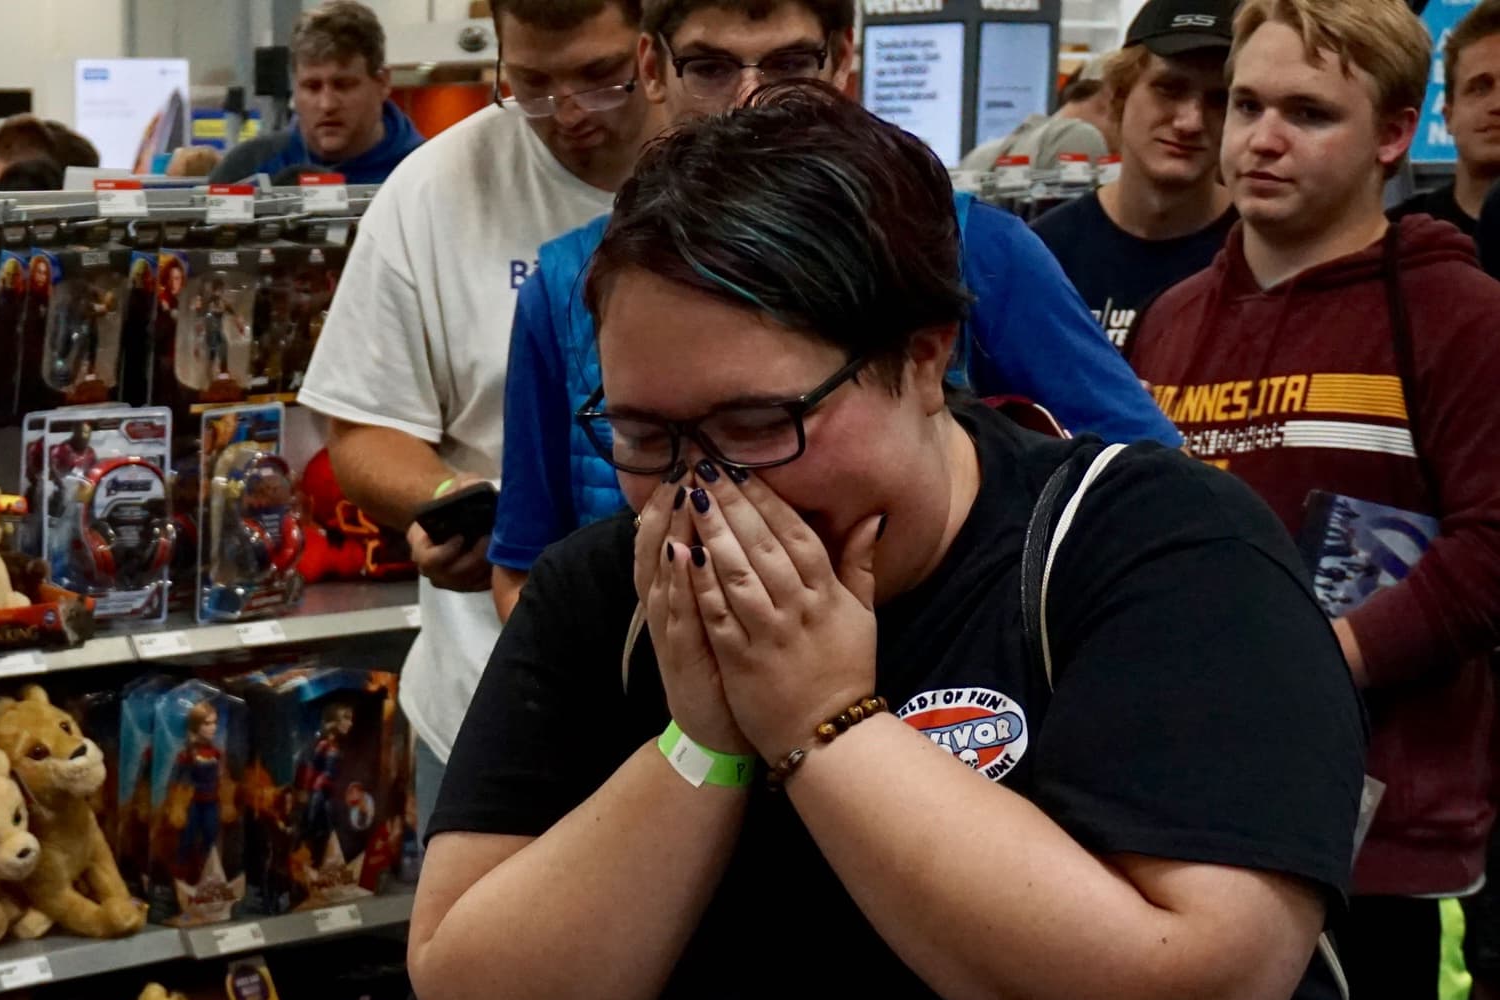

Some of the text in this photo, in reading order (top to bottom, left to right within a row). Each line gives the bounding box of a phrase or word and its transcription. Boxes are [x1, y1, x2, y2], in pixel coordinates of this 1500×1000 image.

[942, 690, 963, 705] OF
[968, 690, 1002, 711] FUN
[986, 752, 1016, 780] UNT
